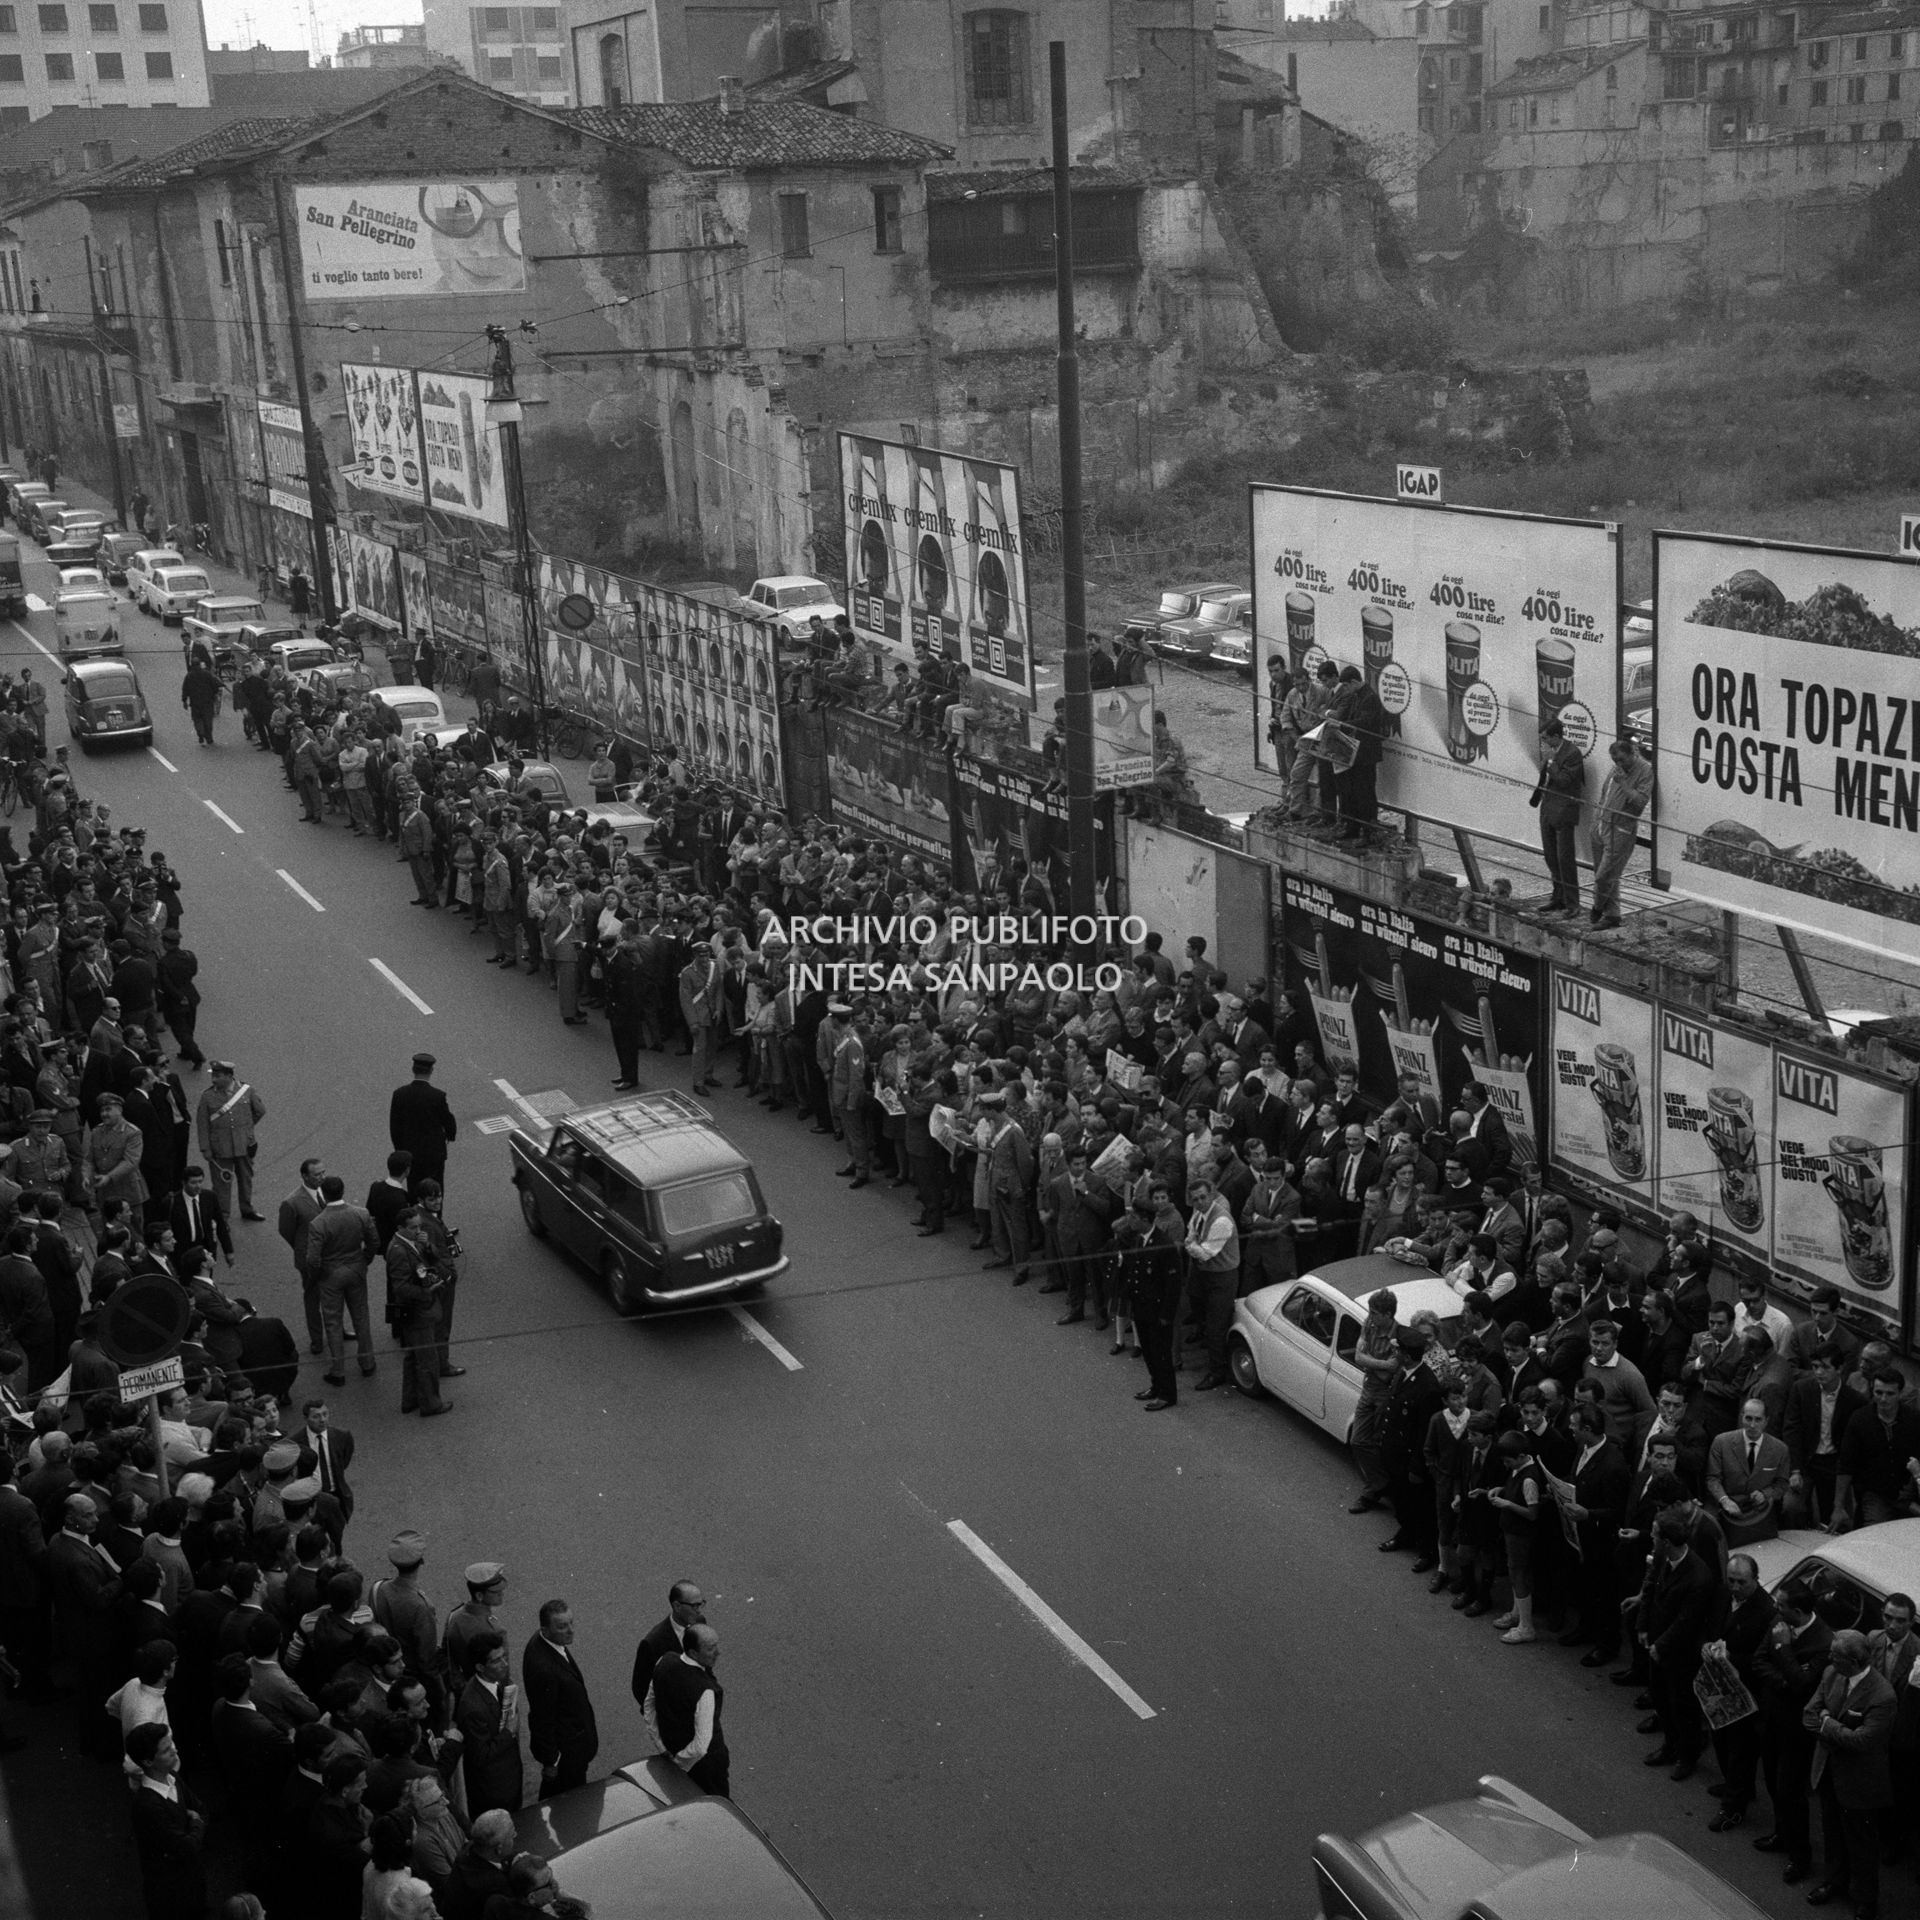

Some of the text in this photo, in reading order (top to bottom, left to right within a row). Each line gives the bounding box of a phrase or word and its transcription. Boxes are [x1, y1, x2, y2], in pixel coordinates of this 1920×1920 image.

[306, 206, 416, 250] San Pellegrino
[347, 200, 418, 233] Aranciata
[312, 268, 423, 285] ti voglio tanto bere!
[1399, 469, 1439, 496] IGAP
[848, 494, 1018, 554] cremfix cremfix cremfix
[1274, 556, 1327, 583] 400 lire
[1347, 568, 1406, 598] 400 lire
[1429, 582, 1496, 613] 400 lire
[1536, 588, 1560, 599] da oggi
[1456, 610, 1505, 625] cosa ne dite?
[1521, 596, 1595, 630] 400 lire
[1550, 626, 1604, 644] cosa ne dite?
[1692, 663, 1760, 732] ORA
[1692, 727, 1803, 807] COSTA
[1361, 904, 1415, 934] ora in Italia
[1362, 920, 1438, 960] un würstel sicuro
[1444, 934, 1505, 966] ora in Italia
[1444, 952, 1531, 993] un würstel sicuro
[1558, 978, 1599, 1022] VITA
[1319, 1011, 1348, 1038] PRINZ
[1666, 1016, 1712, 1065] VITA
[1394, 1045, 1430, 1073] PRINZ
[1558, 1061, 1572, 1074] NEL
[1664, 1092, 1687, 1106] VEDE
[1780, 1060, 1835, 1110] VITA
[1666, 1104, 1708, 1122] NEL MODO
[1667, 1117, 1698, 1132] GIUSTO
[1779, 1140, 1805, 1155] VEDE
[1780, 1153, 1830, 1172] NEL MODO
[1782, 1166, 1817, 1183] GIUSTO
[122, 1363, 180, 1396] PERMANENTE
